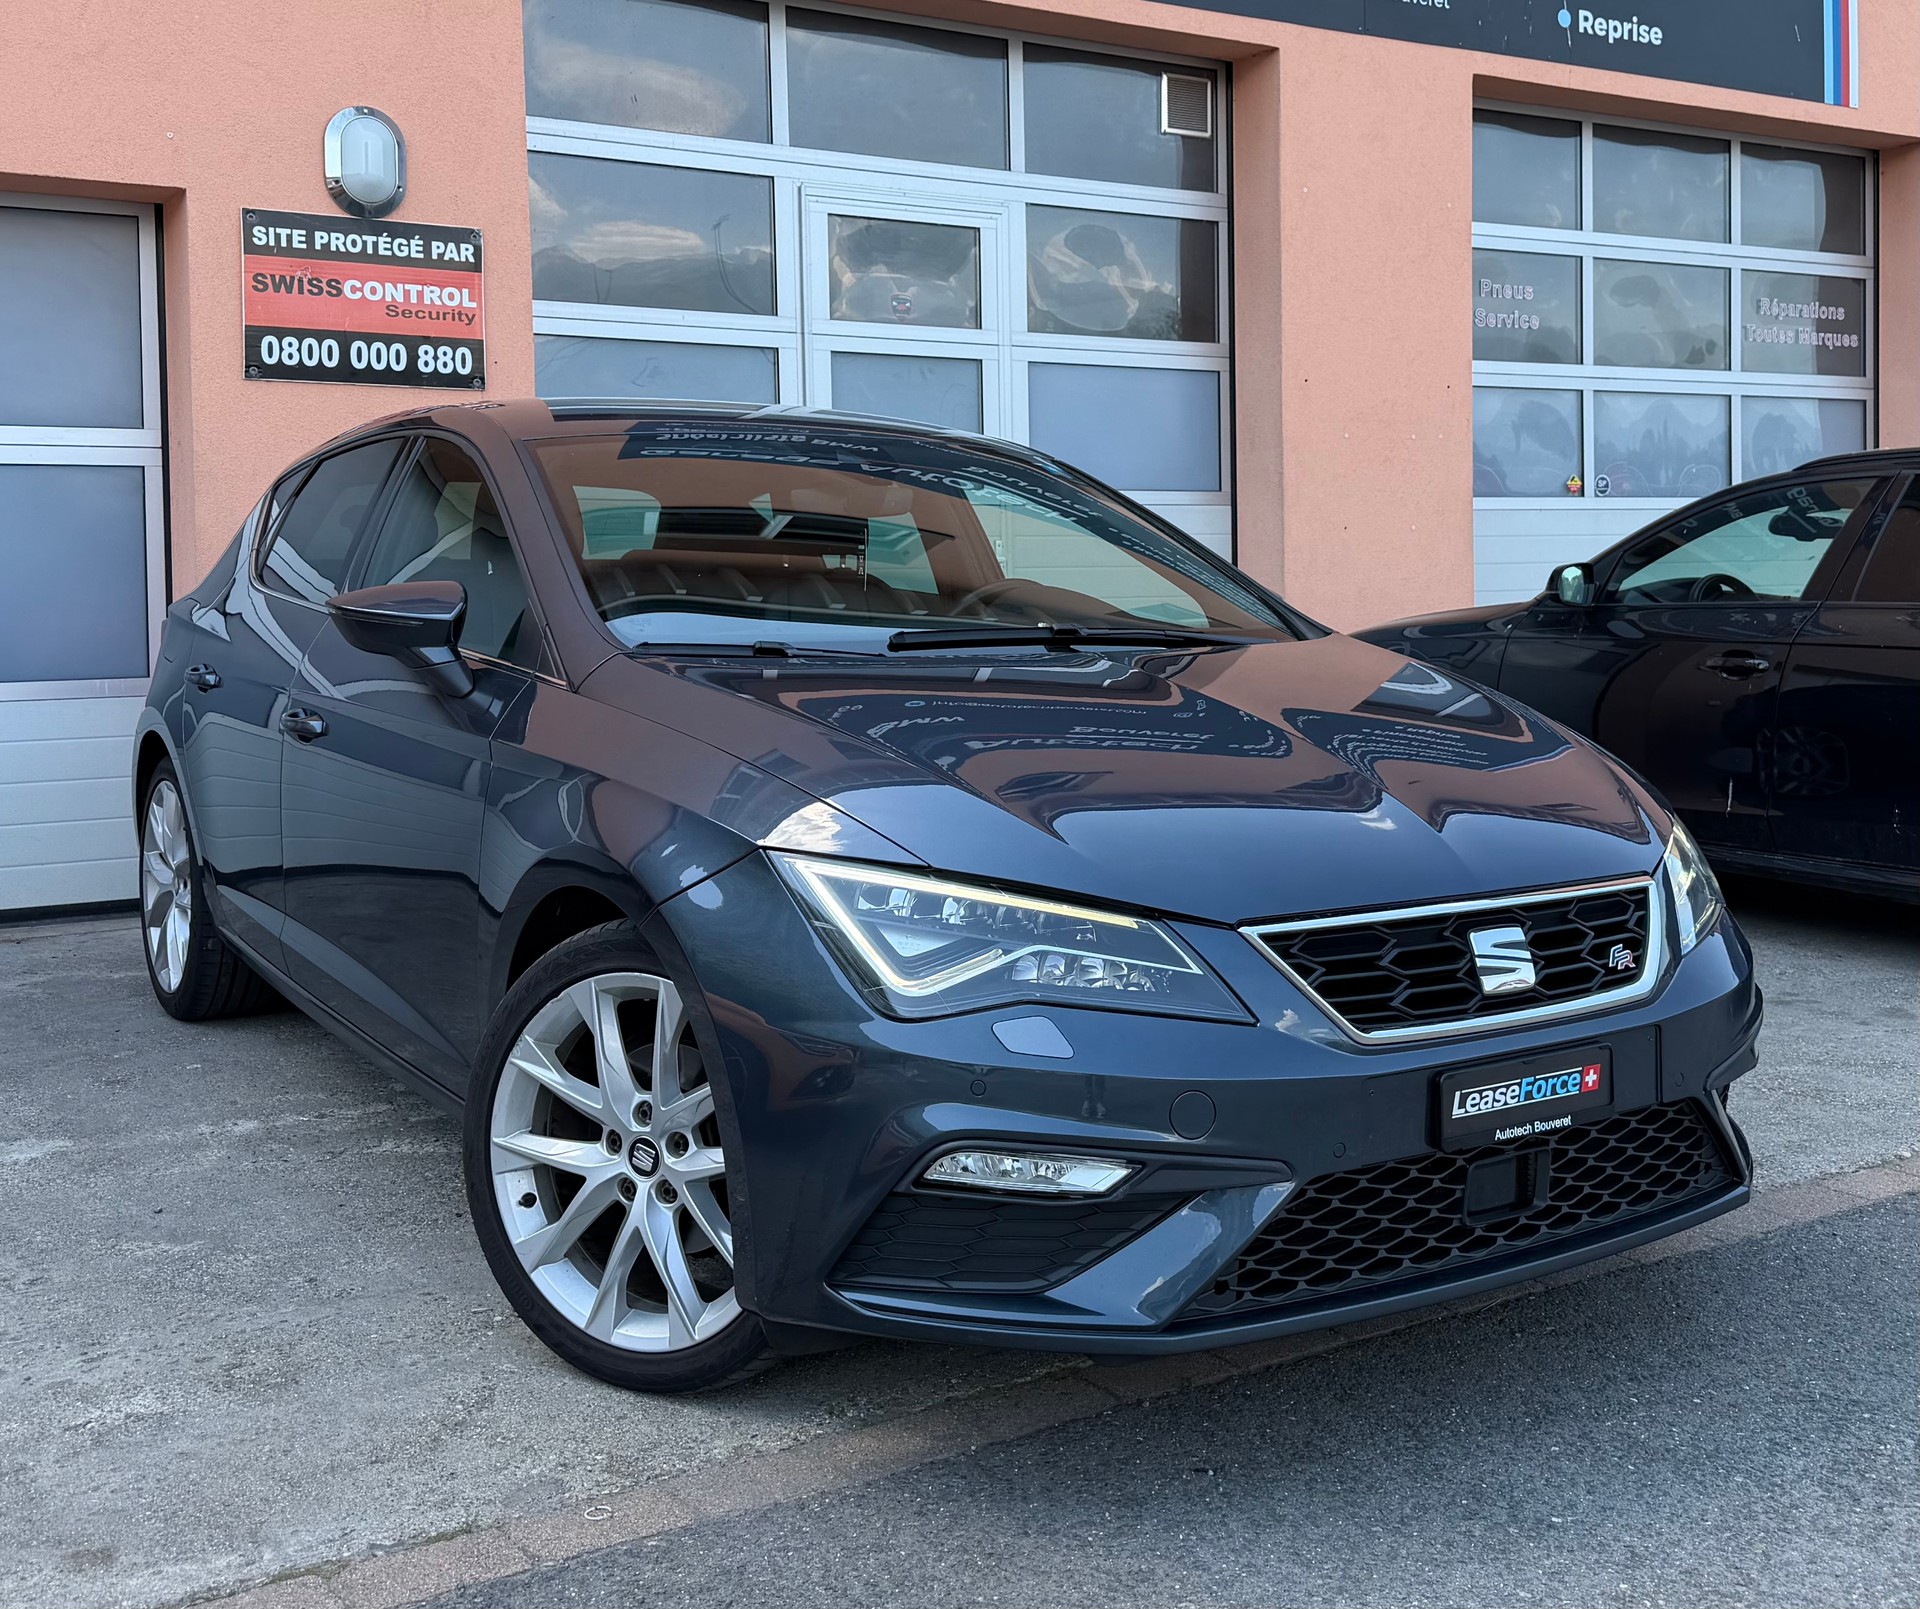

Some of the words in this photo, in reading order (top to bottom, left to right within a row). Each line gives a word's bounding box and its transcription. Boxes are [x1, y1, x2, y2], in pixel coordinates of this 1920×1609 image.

[1578, 9, 1663, 46] Reprise
[252, 225, 307, 249] SITE
[314, 231, 424, 258] PROTÉGÉ
[431, 241, 475, 263] PAR
[1480, 279, 1534, 300] Pneus
[385, 304, 476, 326] Security
[1475, 308, 1540, 330] Service
[1760, 297, 1845, 320] Réparations
[1746, 323, 1795, 344] Toutes
[1799, 327, 1859, 350] Marques
[260, 335, 340, 368] 0800
[350, 340, 407, 372] 000
[417, 344, 473, 375] 880
[1452, 1072, 1581, 1116] LeaseForce
[1494, 1123, 1533, 1141] Autotech
[1534, 1115, 1572, 1132] Bouveret
